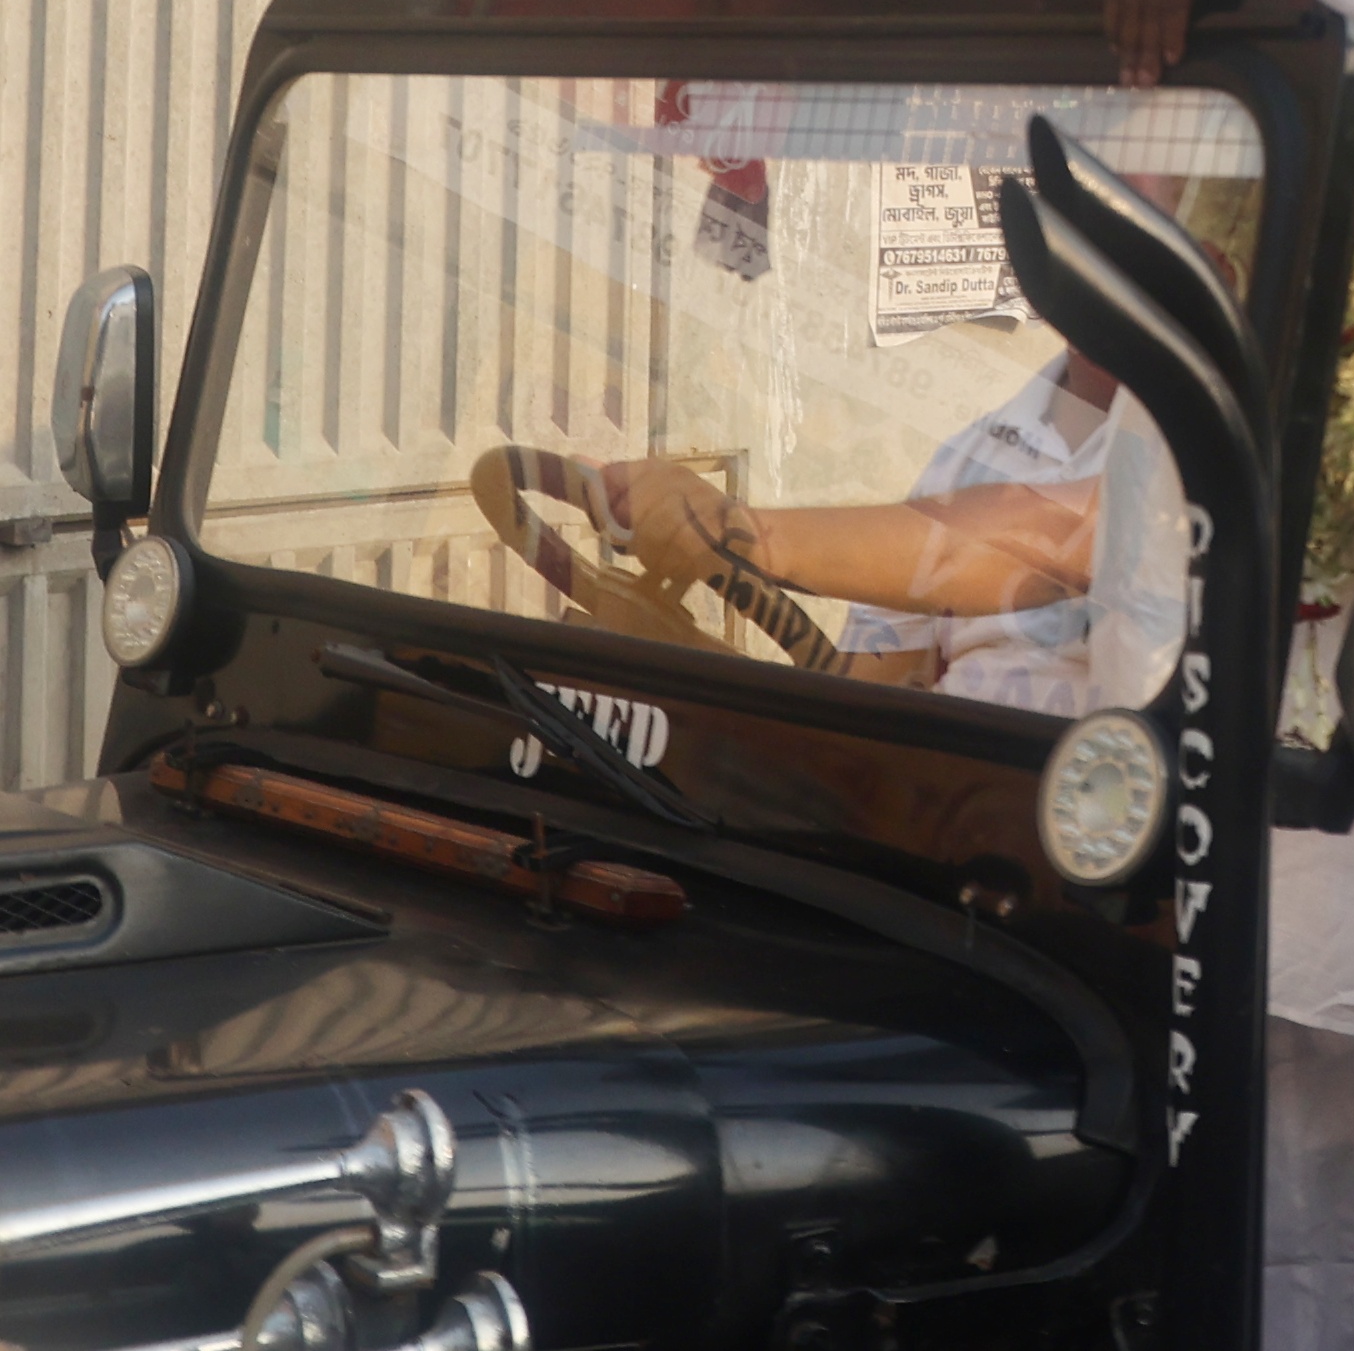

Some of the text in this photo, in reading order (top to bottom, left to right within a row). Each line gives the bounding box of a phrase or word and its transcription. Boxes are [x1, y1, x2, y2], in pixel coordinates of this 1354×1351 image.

[895, 248, 966, 264] 7679514631
[895, 281, 911, 295] Dr.
[915, 279, 958, 296] Sandip
[961, 277, 995, 293] Dutta
[1165, 502, 1214, 1167] DISCOVERY
